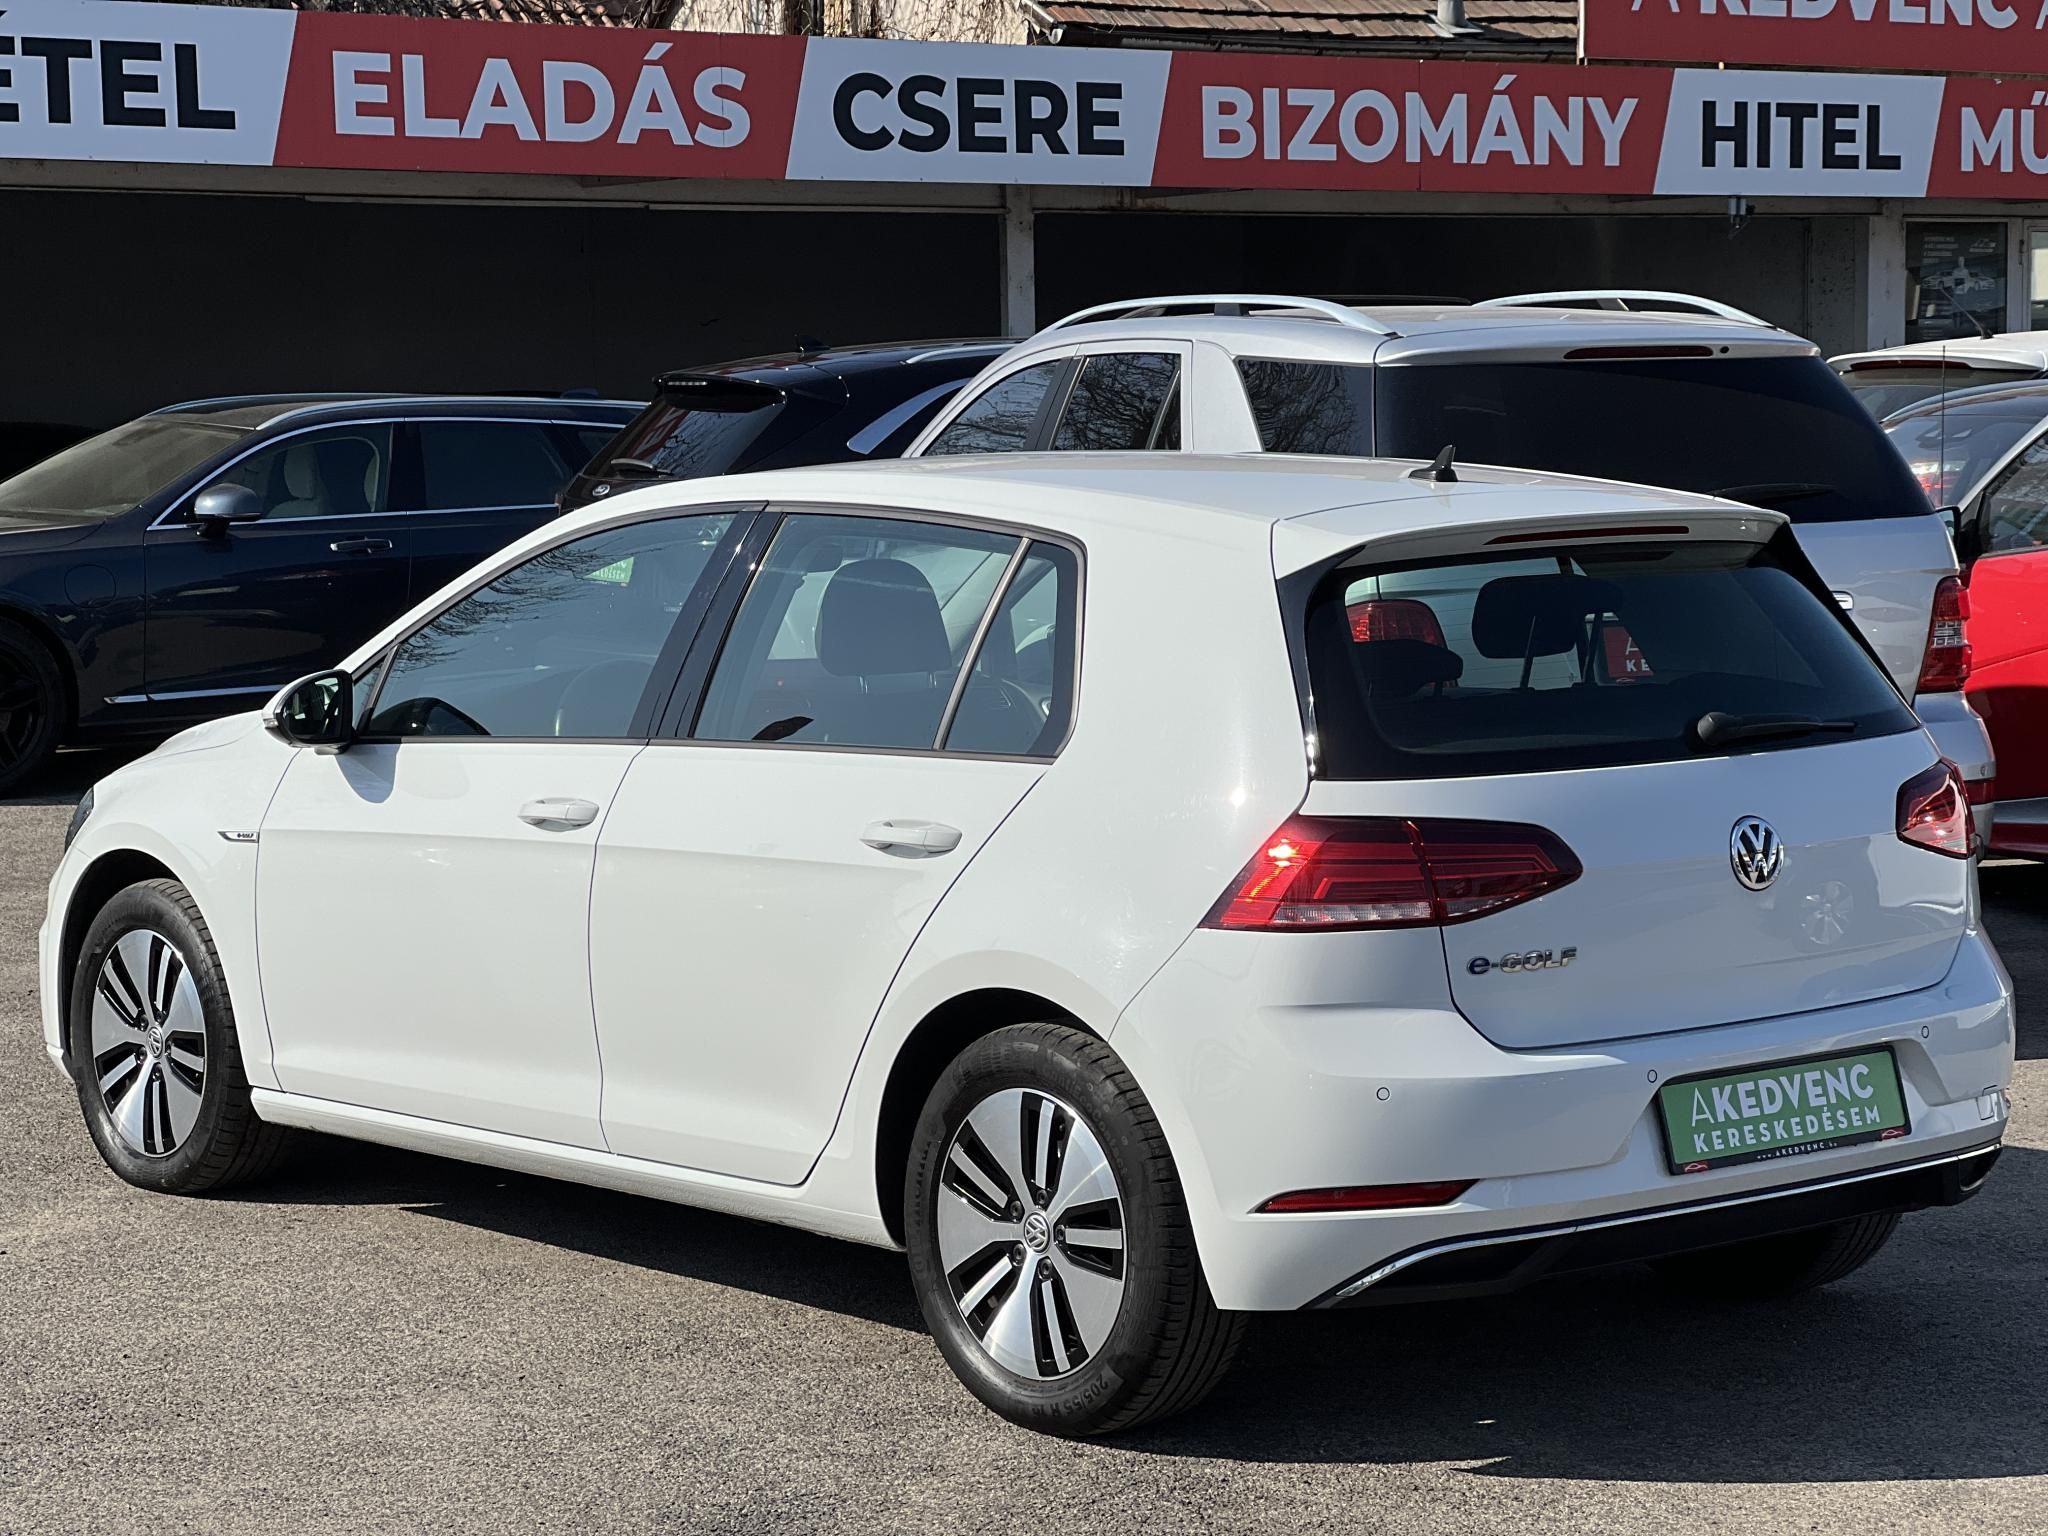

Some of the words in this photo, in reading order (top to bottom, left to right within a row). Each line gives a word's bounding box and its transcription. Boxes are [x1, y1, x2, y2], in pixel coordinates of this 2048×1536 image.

[0, 11, 236, 130] TEL
[332, 41, 751, 148] ELADÁS
[832, 72, 1125, 156] CSERE
[1201, 74, 1639, 167] BIZOMÁNY
[1701, 100, 1902, 171] HITEL
[1466, 946, 1577, 976] e-GOLF
[1691, 1063, 1874, 1128] AKEDVENC
[1692, 1104, 1881, 1154] KERESKEDÉSEM
